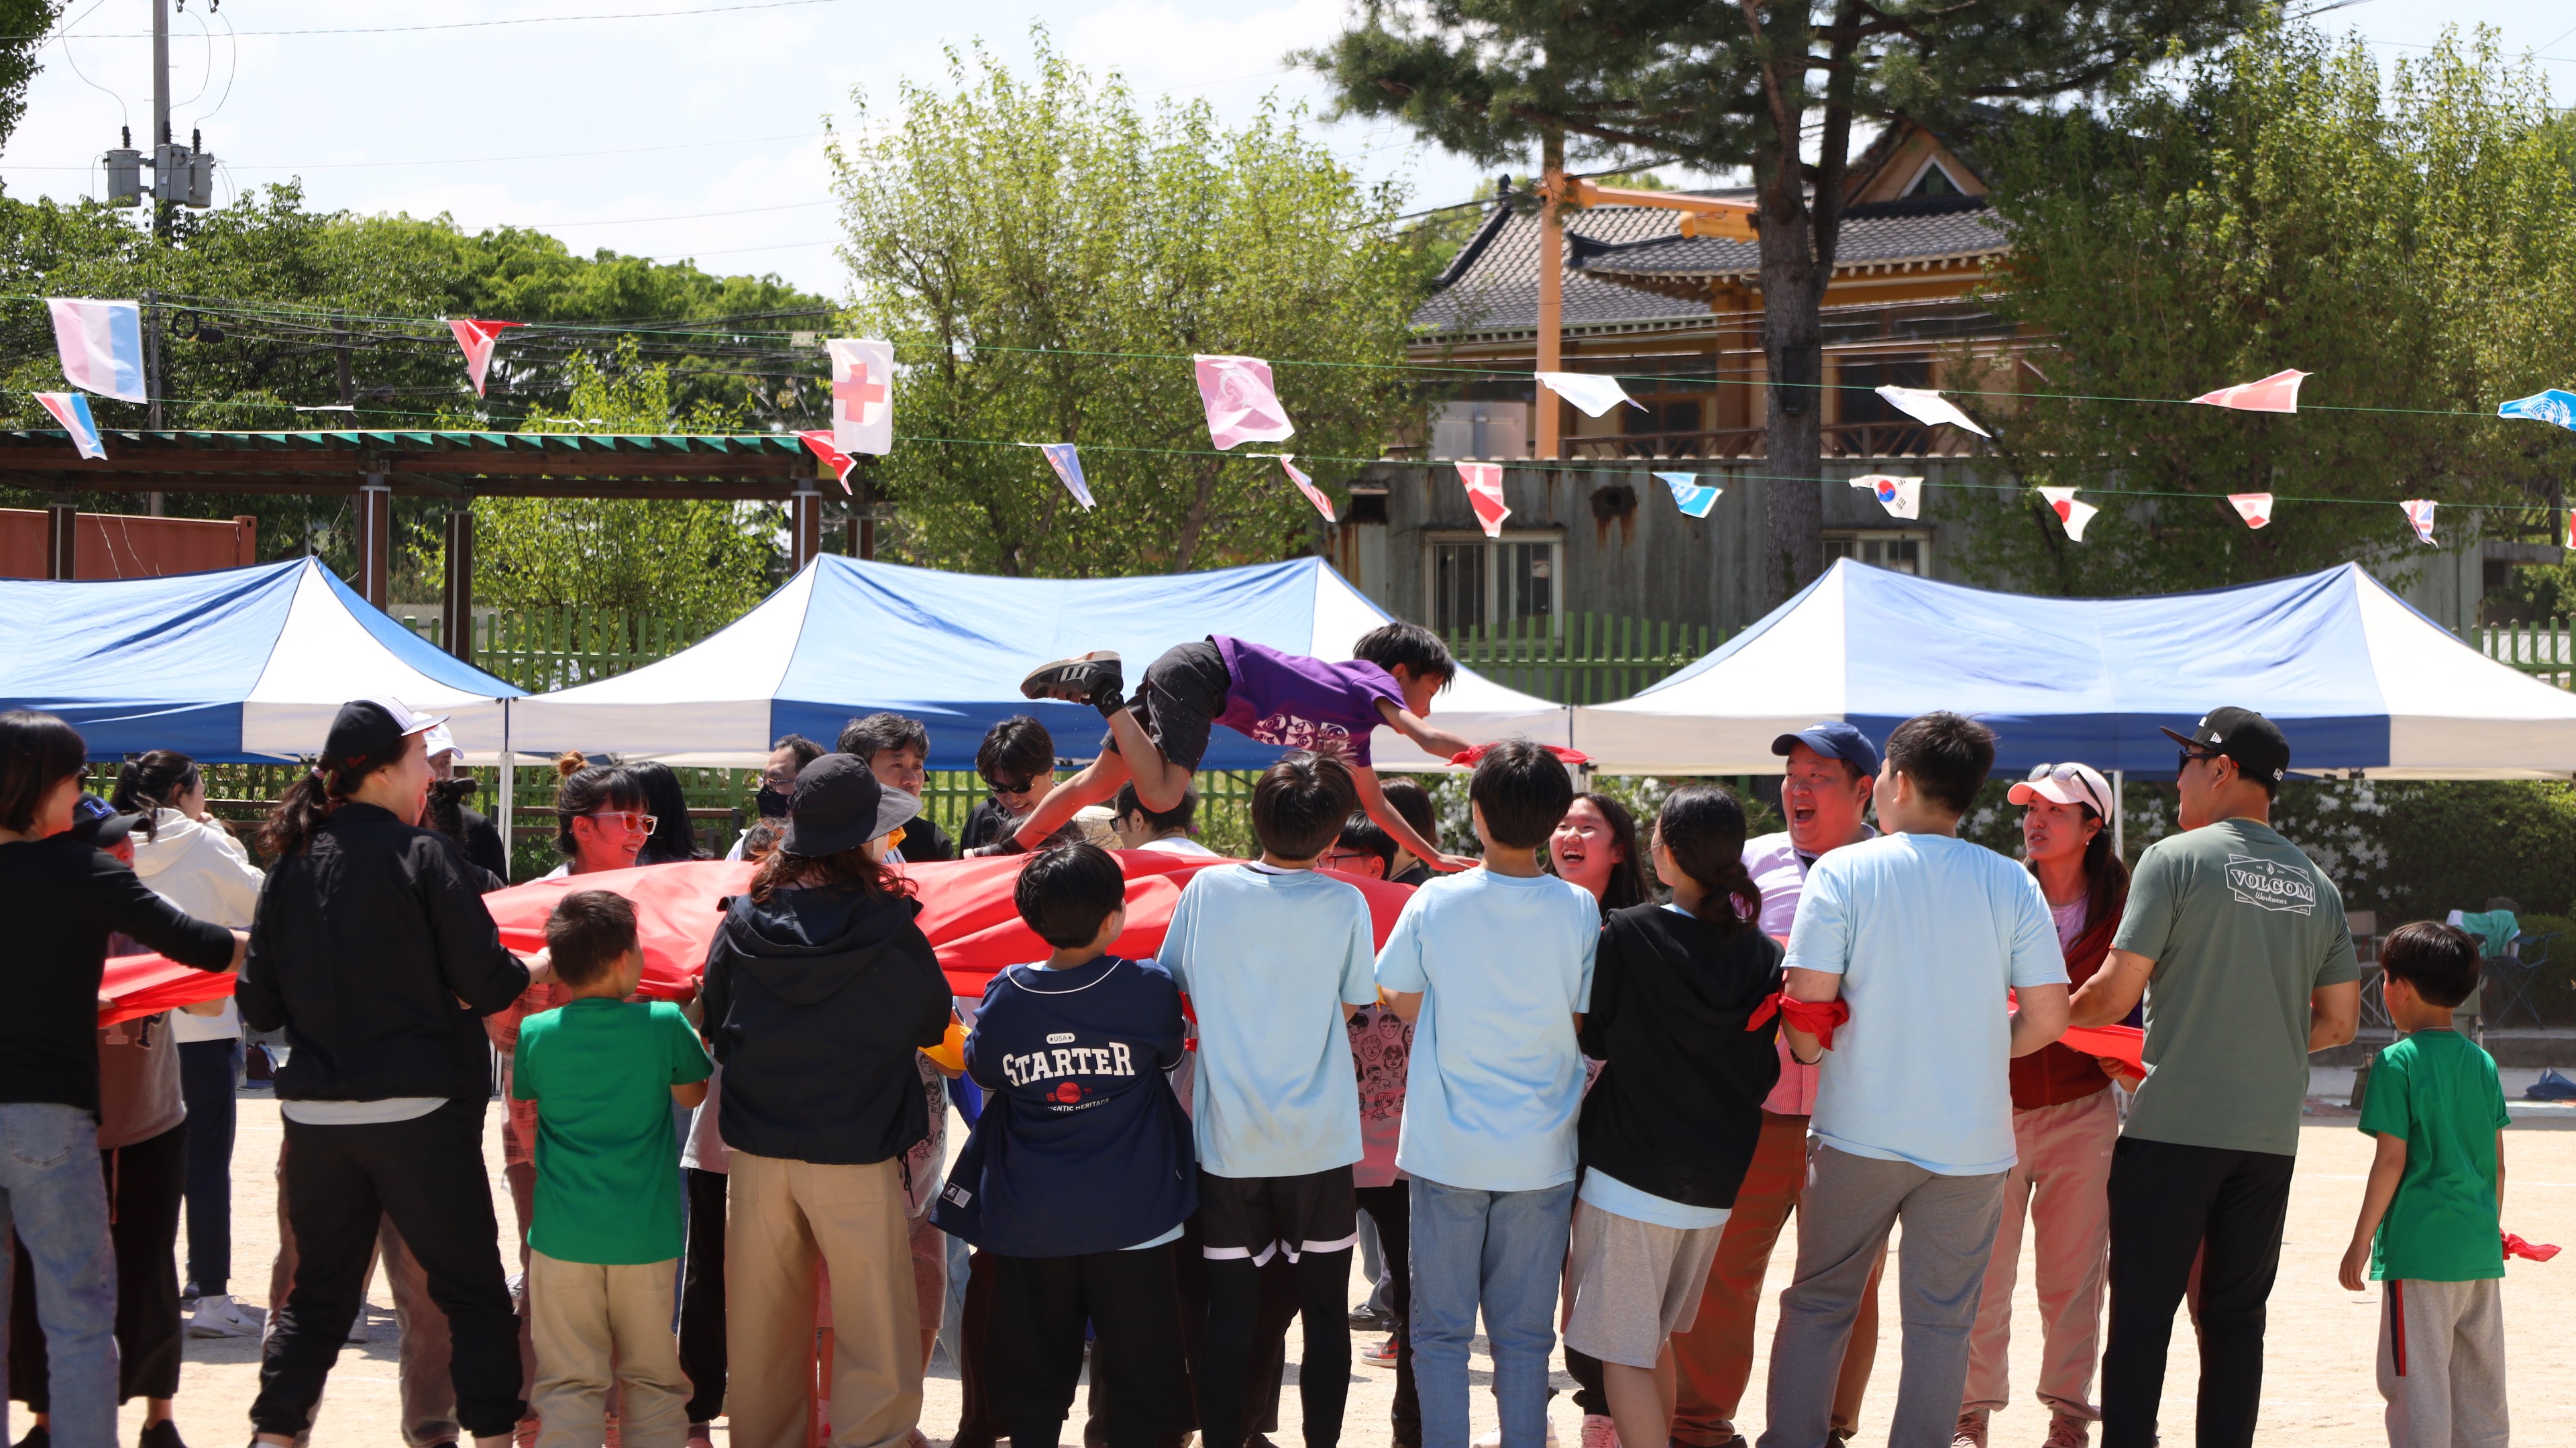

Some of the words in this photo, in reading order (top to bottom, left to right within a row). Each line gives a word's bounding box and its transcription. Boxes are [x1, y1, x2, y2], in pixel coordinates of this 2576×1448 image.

[2230, 869, 2313, 902] VOLCOM
[2255, 890, 2288, 905] Workwear
[1002, 1041, 1135, 1086] STARTER
[1046, 1092, 1056, 1102] 19
